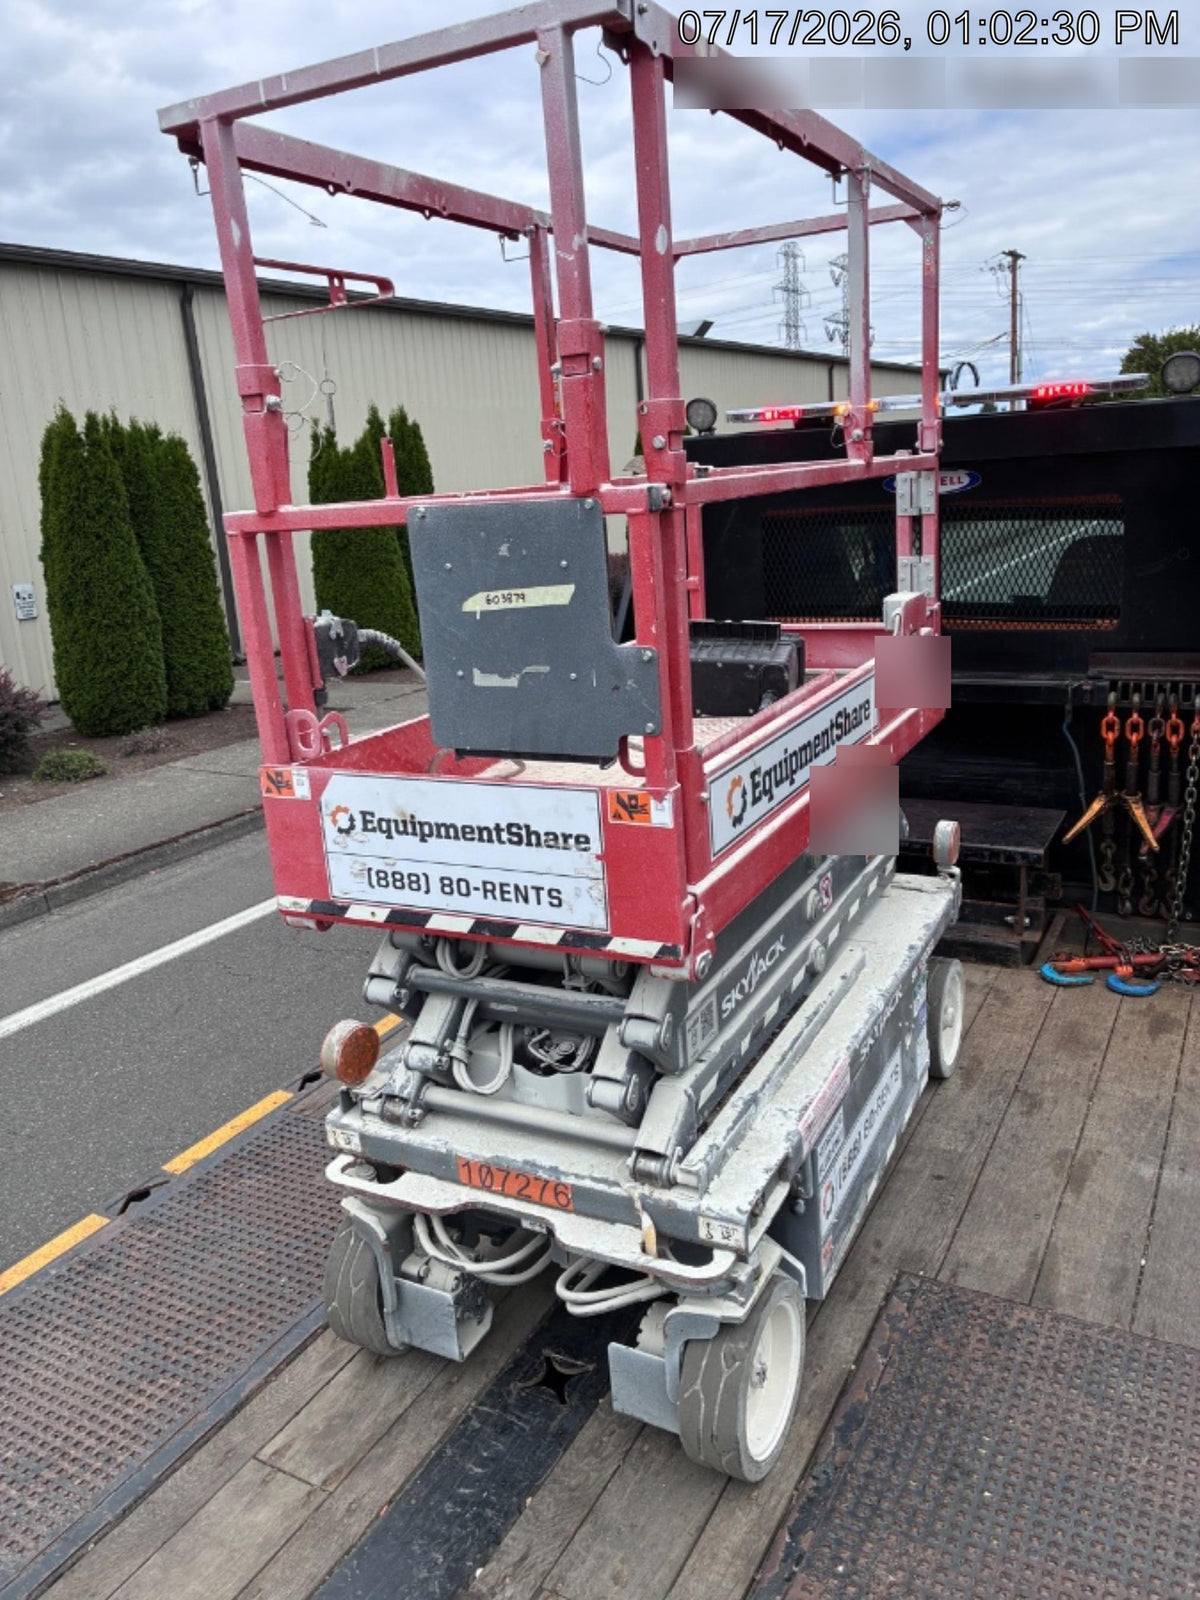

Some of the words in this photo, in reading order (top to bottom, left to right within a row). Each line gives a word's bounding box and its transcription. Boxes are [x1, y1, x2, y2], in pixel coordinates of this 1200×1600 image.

[486, 592, 526, 605] 603879
[750, 698, 871, 807] EquipmentShare
[361, 810, 592, 853] EquipmentShare
[367, 866, 431, 896] (888)
[440, 875, 564, 909] 80-RENTS
[721, 935, 787, 1019] SKYJACK
[462, 1160, 572, 1208] 107276
